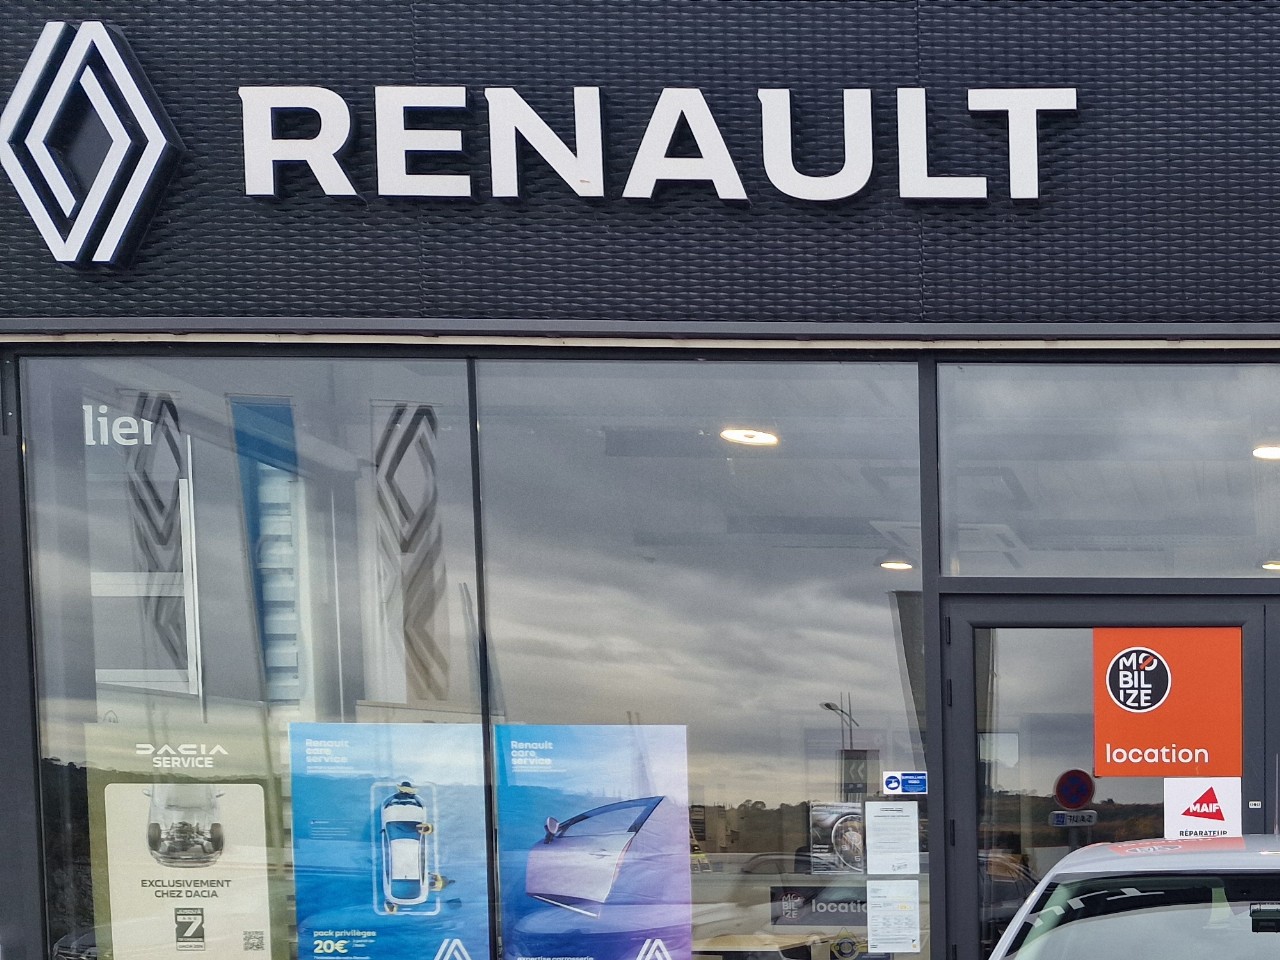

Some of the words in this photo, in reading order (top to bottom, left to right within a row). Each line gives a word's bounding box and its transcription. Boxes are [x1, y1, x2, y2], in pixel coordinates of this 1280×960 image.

[238, 85, 1078, 201] RENAULT
[135, 744, 229, 755] DACIA
[511, 741, 553, 749] Renault
[1106, 743, 1209, 763] location
[152, 757, 214, 768] SERVICE
[1189, 803, 1220, 813] MAIF
[141, 880, 232, 888] EXCLUSIVEMENT
[154, 890, 183, 898] CHEZ
[185, 890, 219, 898] DACIA
[313, 940, 349, 954] 20€
